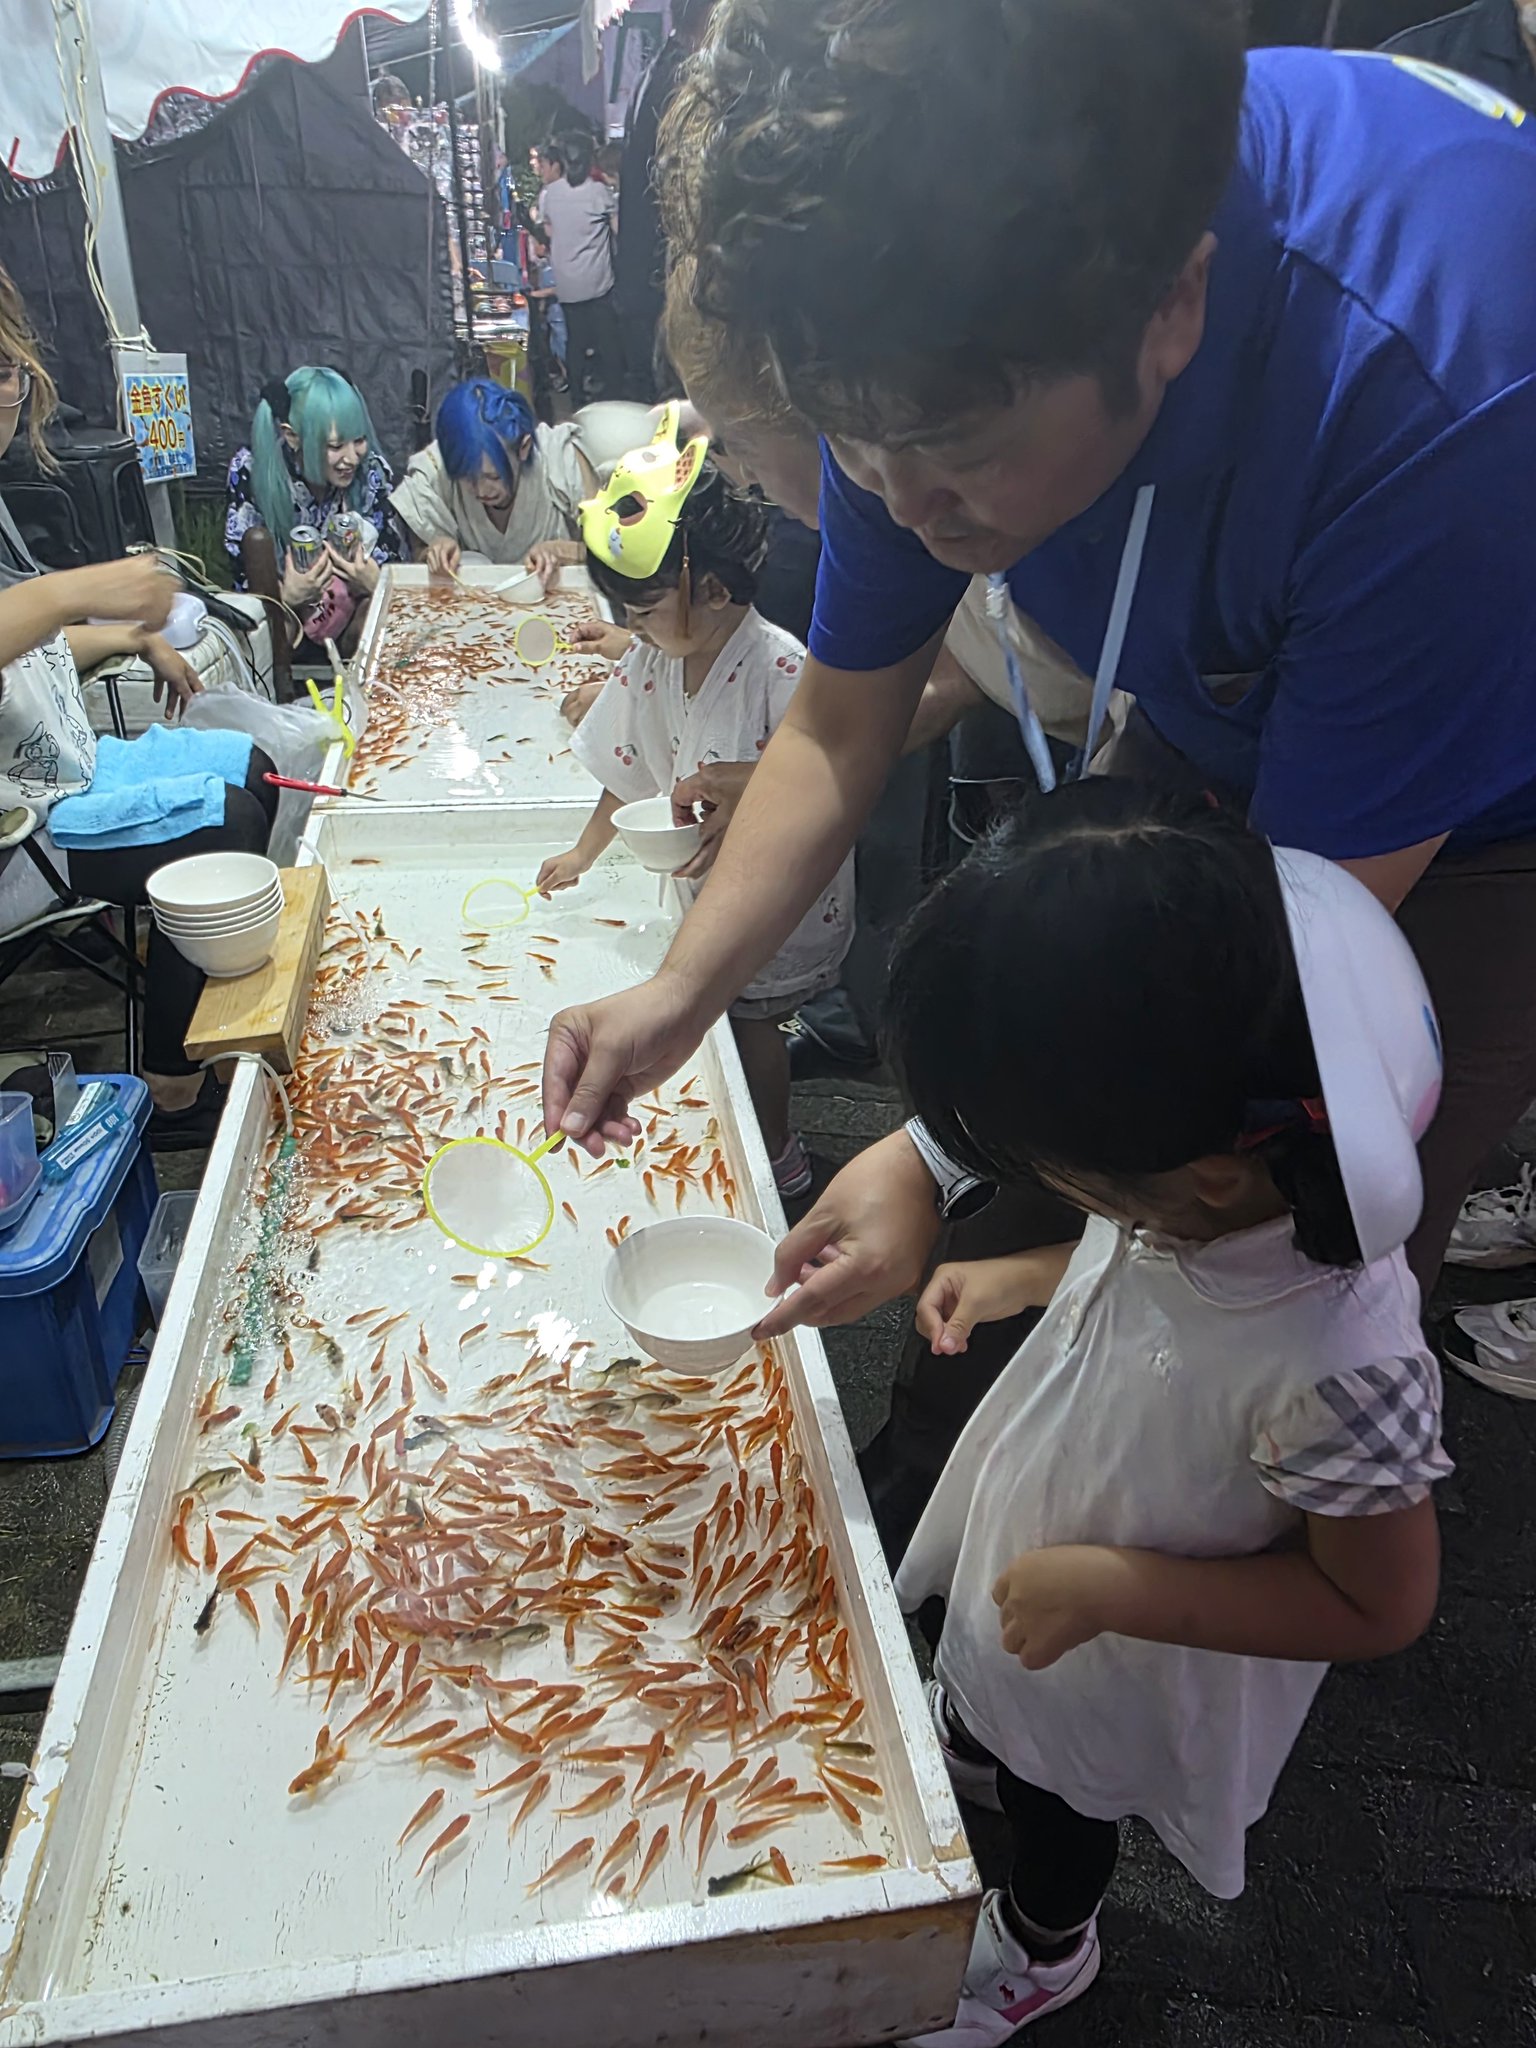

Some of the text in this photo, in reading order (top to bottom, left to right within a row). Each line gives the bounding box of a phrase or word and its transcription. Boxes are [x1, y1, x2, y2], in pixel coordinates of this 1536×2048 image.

[129, 384, 187, 414] 金魚すくい
